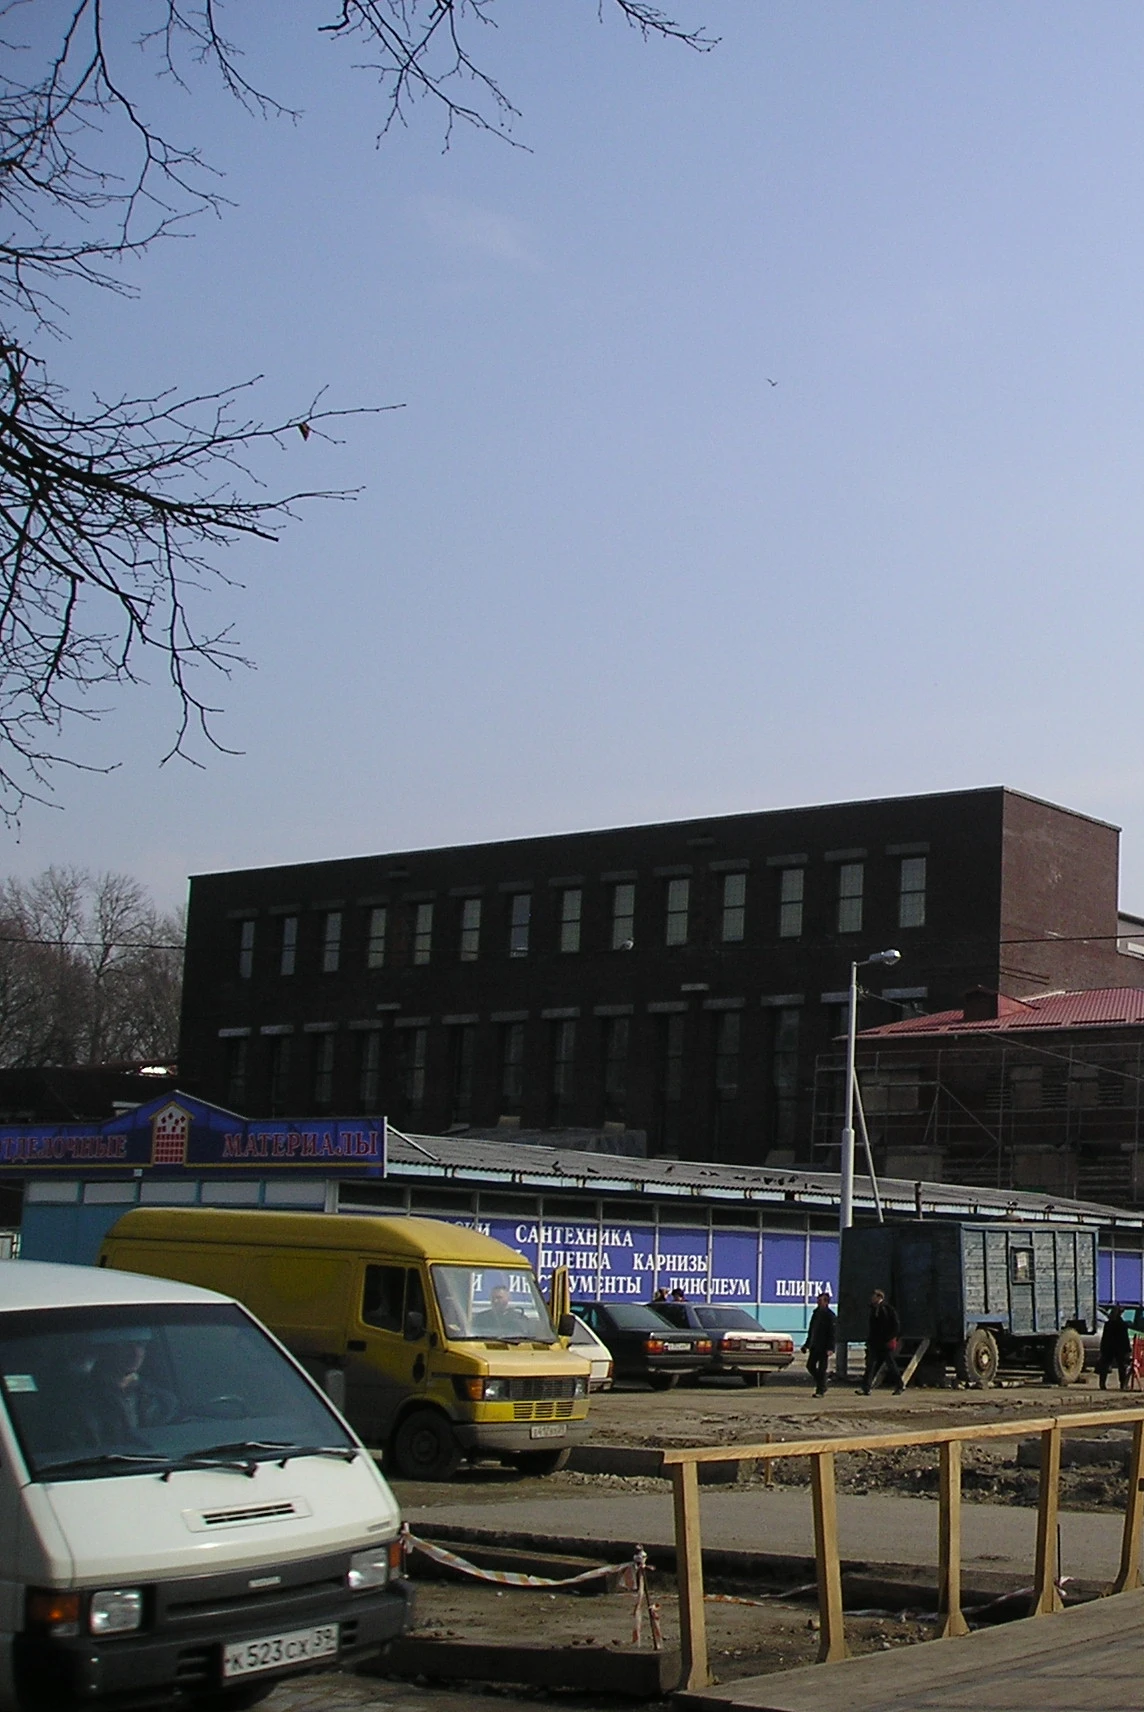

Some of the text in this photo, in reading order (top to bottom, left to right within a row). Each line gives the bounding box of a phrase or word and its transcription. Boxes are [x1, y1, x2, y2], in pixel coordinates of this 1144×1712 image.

[0, 1130, 379, 1163] ТДЕЛОЧНЫЕ МАТЕРИАЛЫ
[515, 1224, 634, 1248] САНТЕХНИКА
[540, 1249, 710, 1272] ПЛЕНКА КАРНИЗЫ
[668, 1277, 751, 1295] ЛИНОЛЕУМ
[776, 1280, 833, 1297] ПЛИТКА
